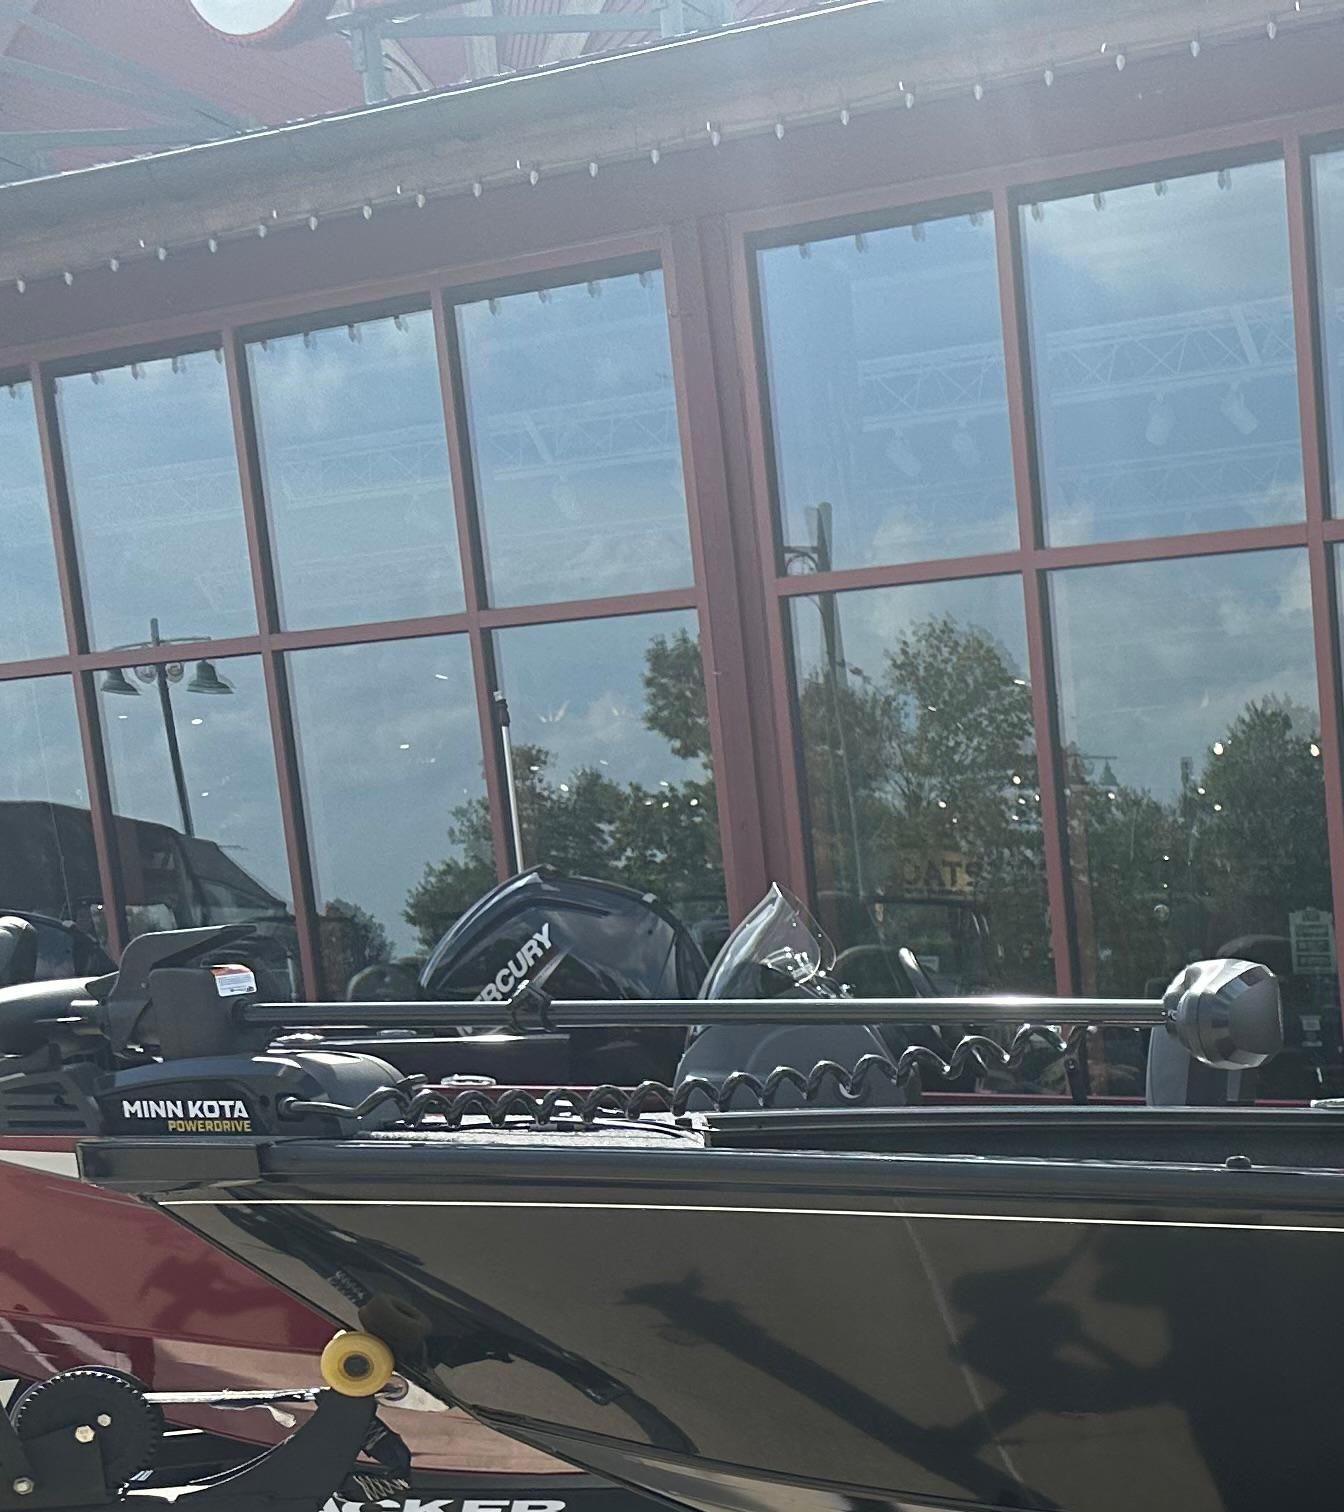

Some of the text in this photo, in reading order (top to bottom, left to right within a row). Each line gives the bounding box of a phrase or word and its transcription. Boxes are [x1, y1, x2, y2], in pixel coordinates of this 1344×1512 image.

[122, 1100, 249, 1118] MINN KOTA
[168, 1120, 252, 1132] POWERDRIVE
